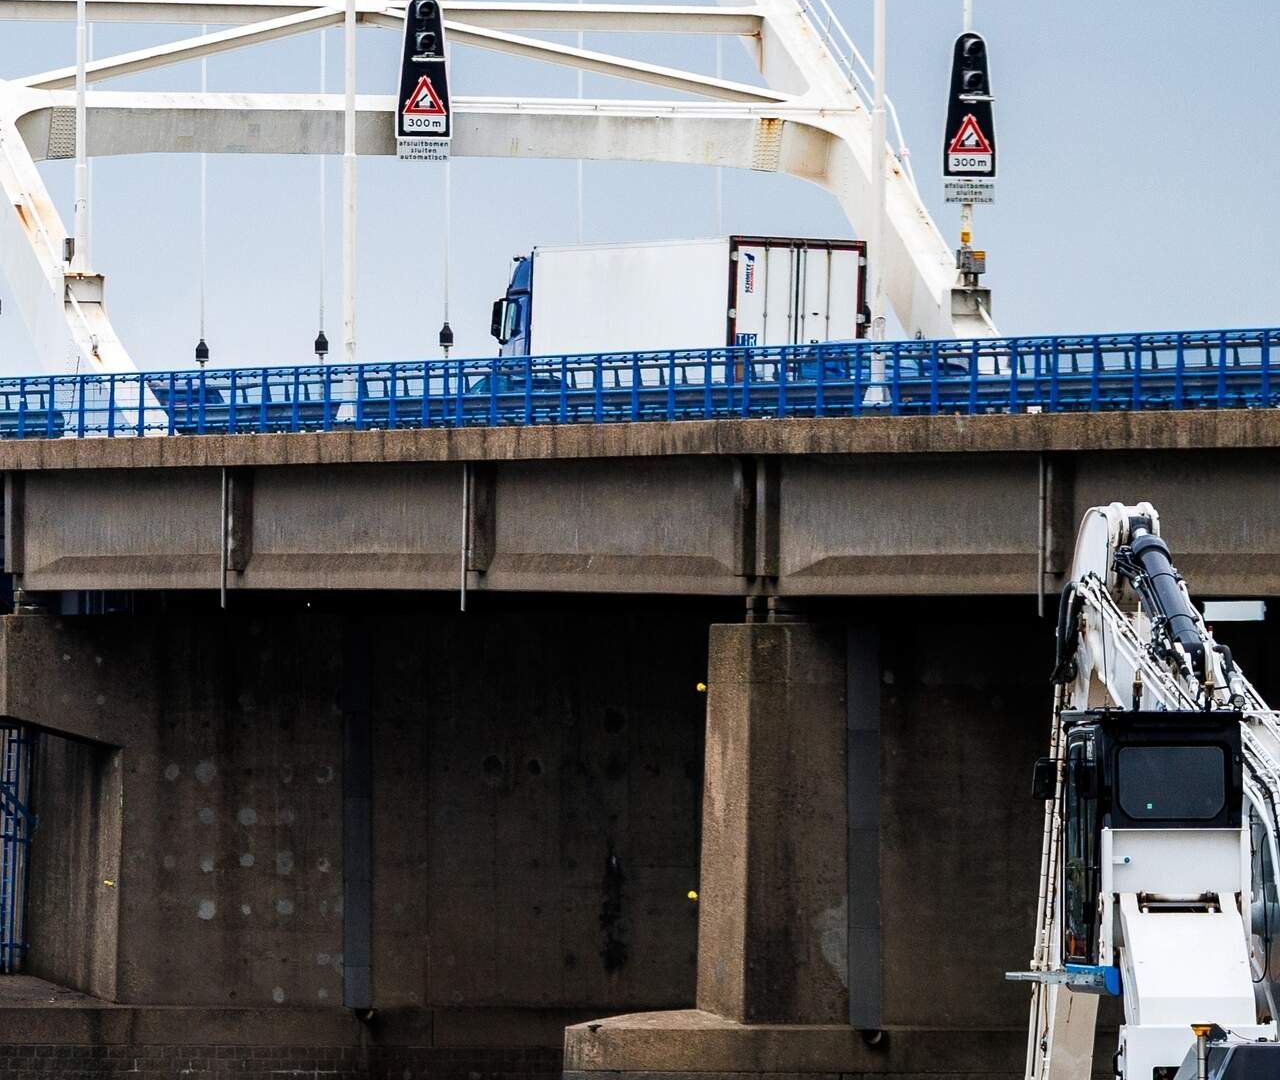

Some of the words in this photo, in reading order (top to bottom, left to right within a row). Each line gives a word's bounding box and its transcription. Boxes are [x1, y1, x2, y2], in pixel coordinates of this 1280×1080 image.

[408, 119, 430, 128] 300
[432, 120, 441, 128] m
[953, 158, 975, 167] 300
[738, 334, 756, 346] TIR
